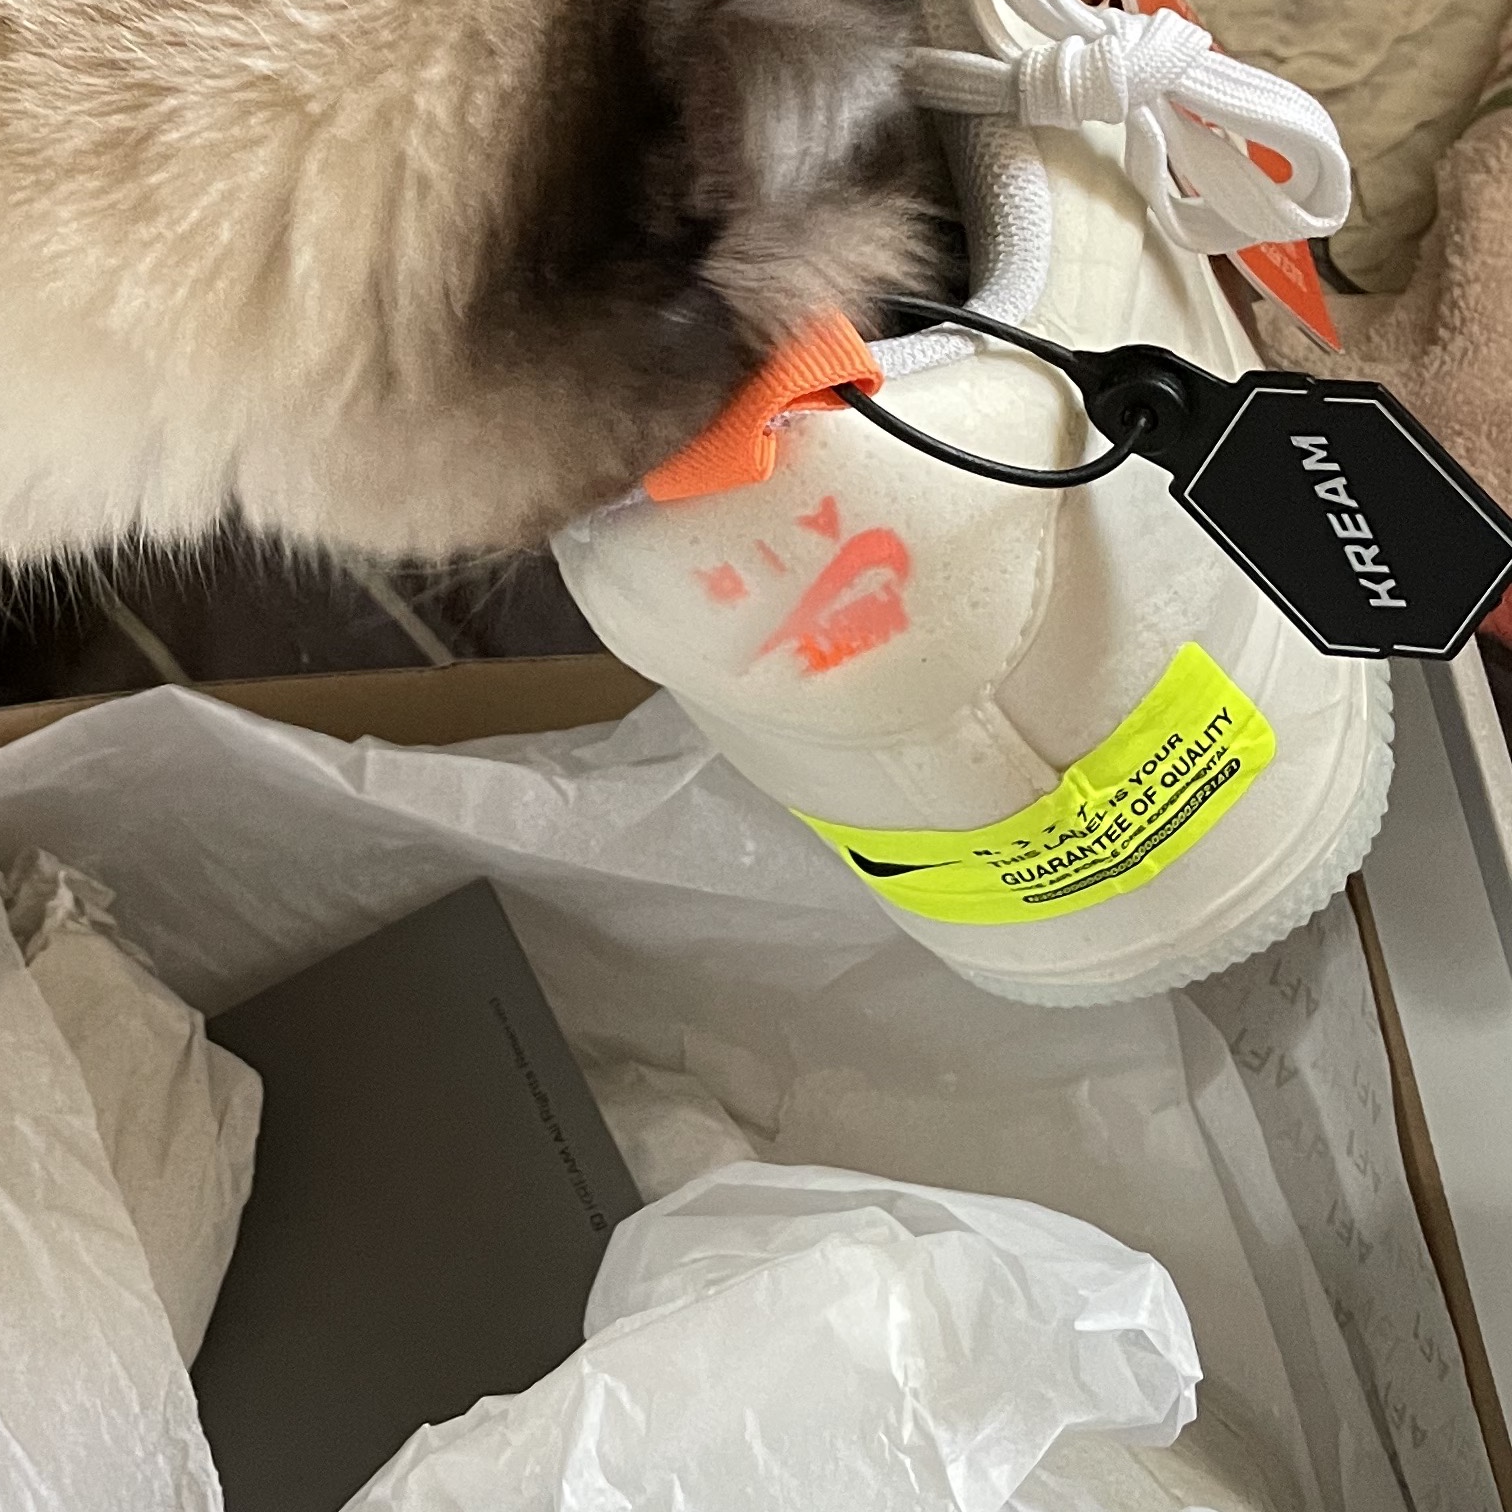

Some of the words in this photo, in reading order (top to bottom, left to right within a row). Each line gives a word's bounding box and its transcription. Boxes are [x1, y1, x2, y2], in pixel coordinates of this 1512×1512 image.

[1290, 436, 1407, 607] KREAM
[1000, 812, 1133, 886] GUARANTEE
[1130, 785, 1157, 817] OF
[1160, 706, 1233, 788] QUALITY
[1108, 788, 1129, 807] IS
[1128, 733, 1184, 786] YOUR
